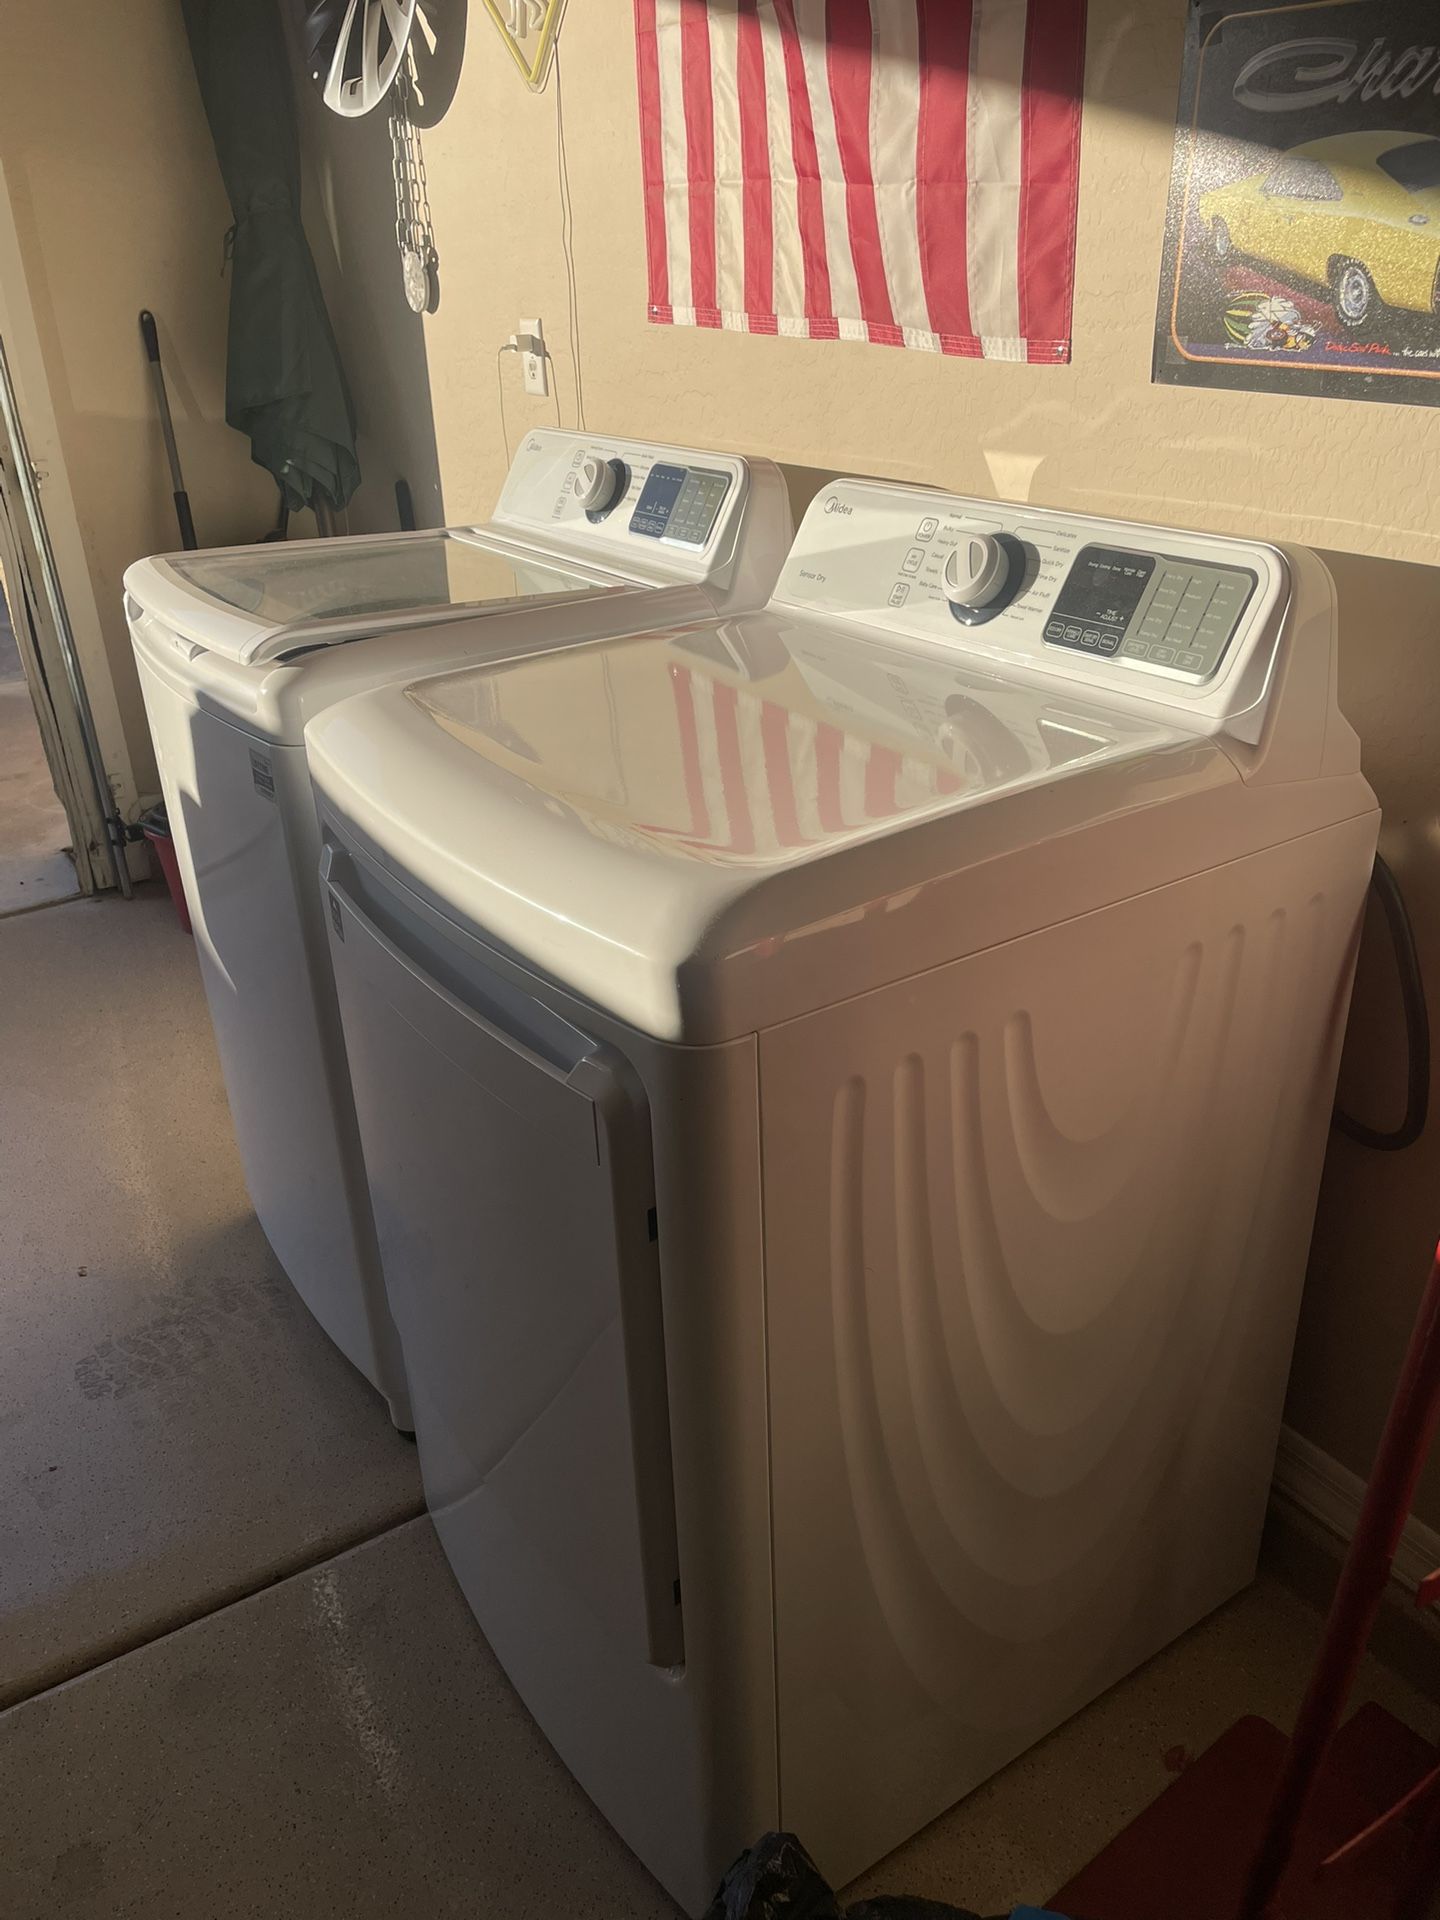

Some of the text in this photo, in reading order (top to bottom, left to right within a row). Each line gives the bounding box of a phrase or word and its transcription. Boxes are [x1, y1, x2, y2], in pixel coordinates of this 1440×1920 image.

[824, 496, 853, 516] Midea
[1042, 558, 1064, 569] Quick Dry
[799, 570, 826, 582] Sensor Dry
